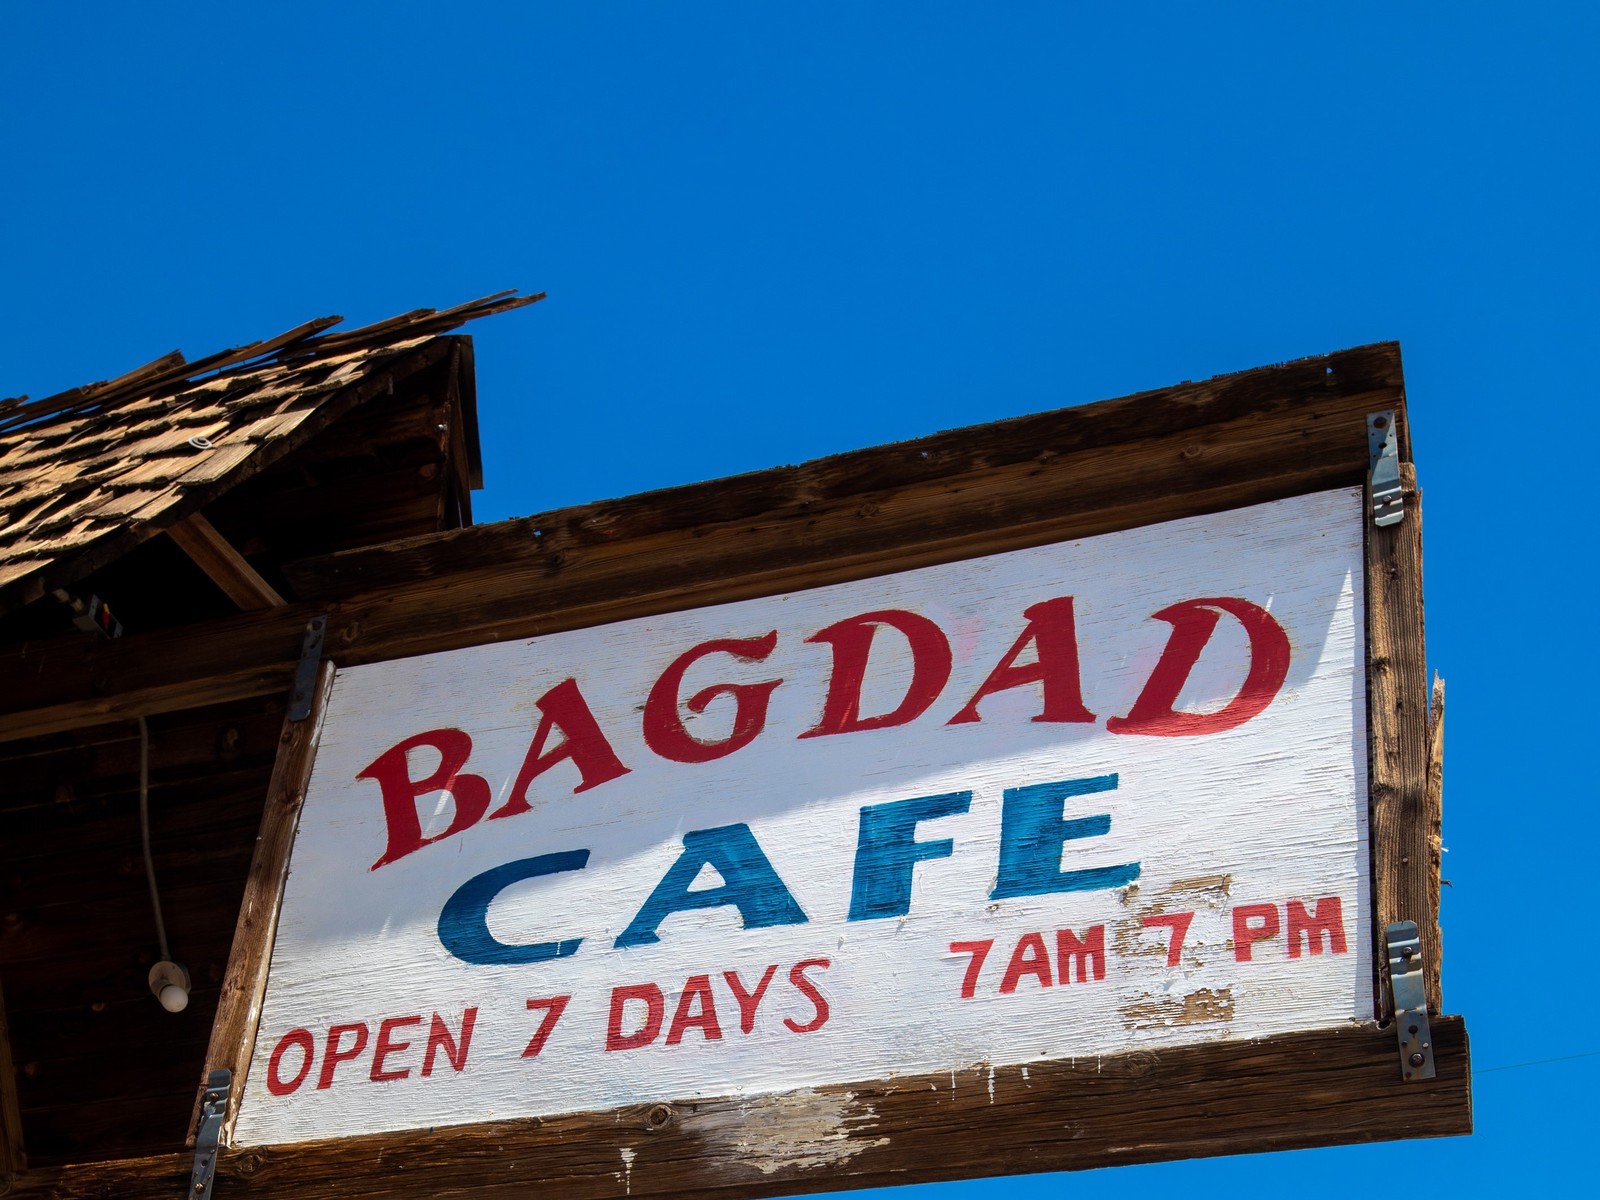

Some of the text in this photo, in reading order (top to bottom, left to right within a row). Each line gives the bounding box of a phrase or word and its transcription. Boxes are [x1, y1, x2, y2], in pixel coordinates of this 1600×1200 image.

[356, 596, 1291, 871] BAGDAD
[437, 772, 1141, 966] CAFE
[266, 1007, 479, 1097] OPEN
[519, 995, 571, 1059] 7
[605, 958, 831, 1052] DAYS
[1141, 911, 1195, 967] 7
[1231, 896, 1349, 963] PM
